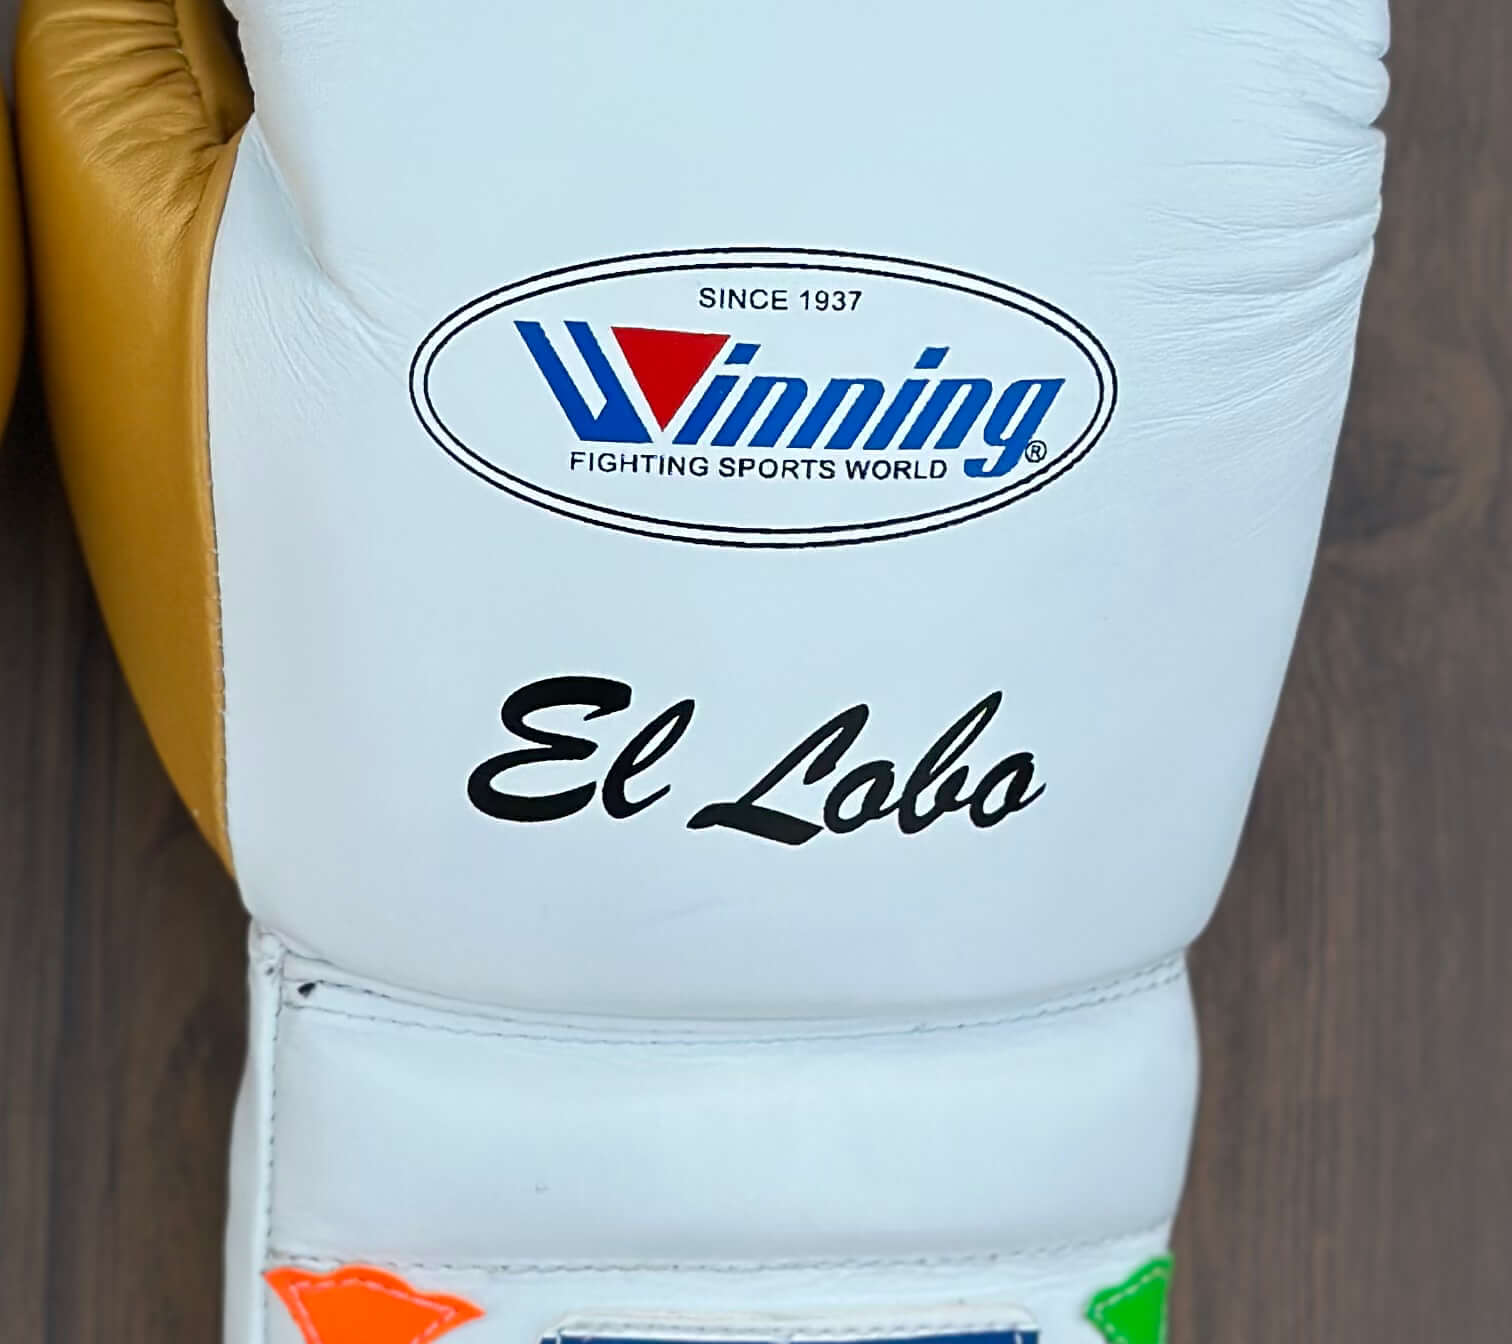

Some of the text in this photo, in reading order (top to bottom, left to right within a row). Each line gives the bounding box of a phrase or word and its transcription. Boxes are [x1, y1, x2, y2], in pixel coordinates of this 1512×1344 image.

[699, 286, 863, 313] SINCE 1937
[513, 319, 1066, 478] Winning
[569, 450, 948, 480] FIGHTING SPORTS WORLD
[466, 675, 1047, 846] El Lobo
